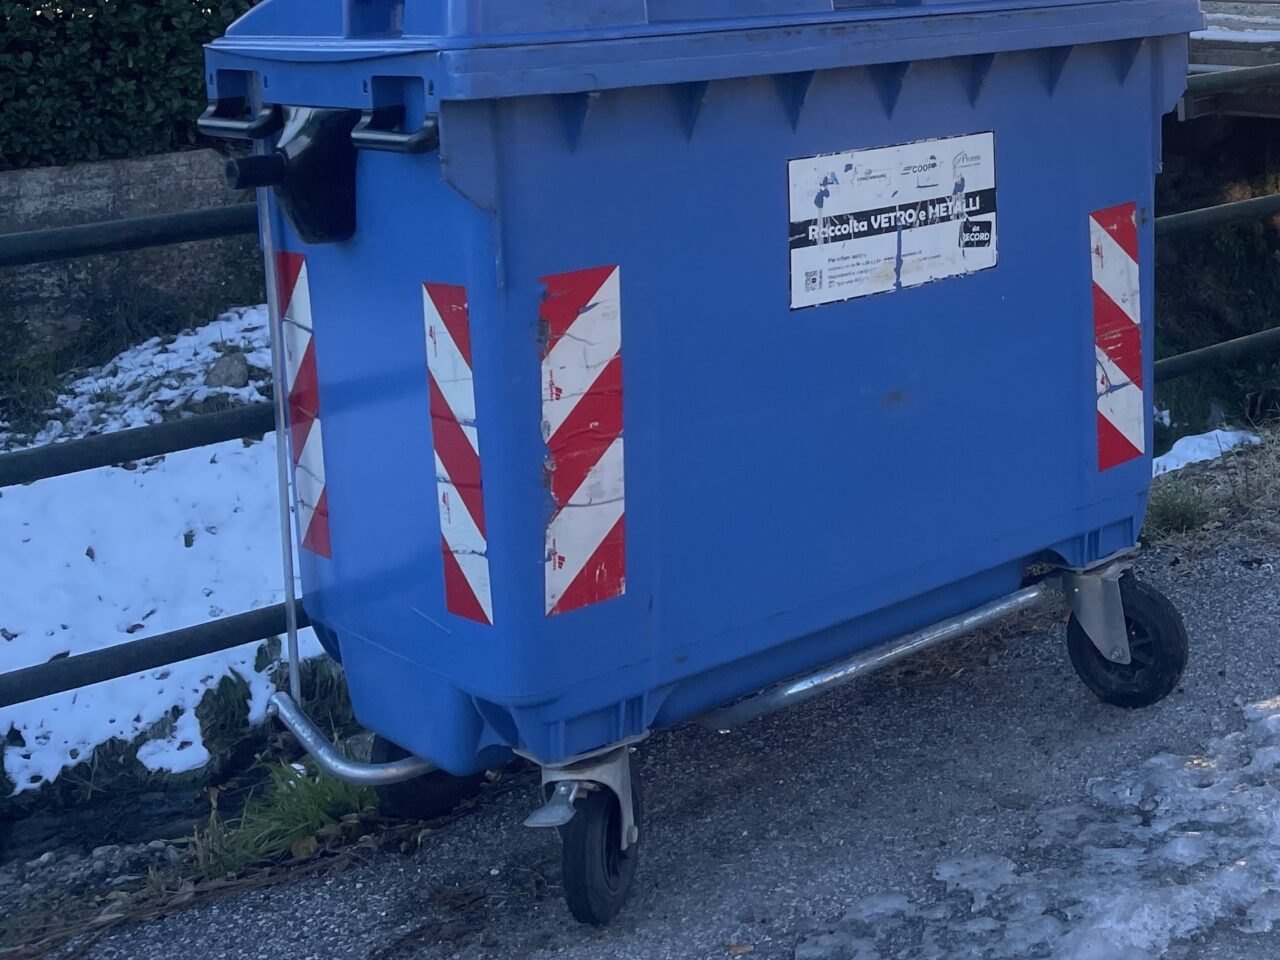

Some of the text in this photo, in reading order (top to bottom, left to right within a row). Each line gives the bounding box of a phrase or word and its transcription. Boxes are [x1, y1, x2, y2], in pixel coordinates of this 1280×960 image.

[809, 219, 868, 240] Raccolta
[870, 208, 916, 229] VETRO
[928, 196, 980, 219] METALLI
